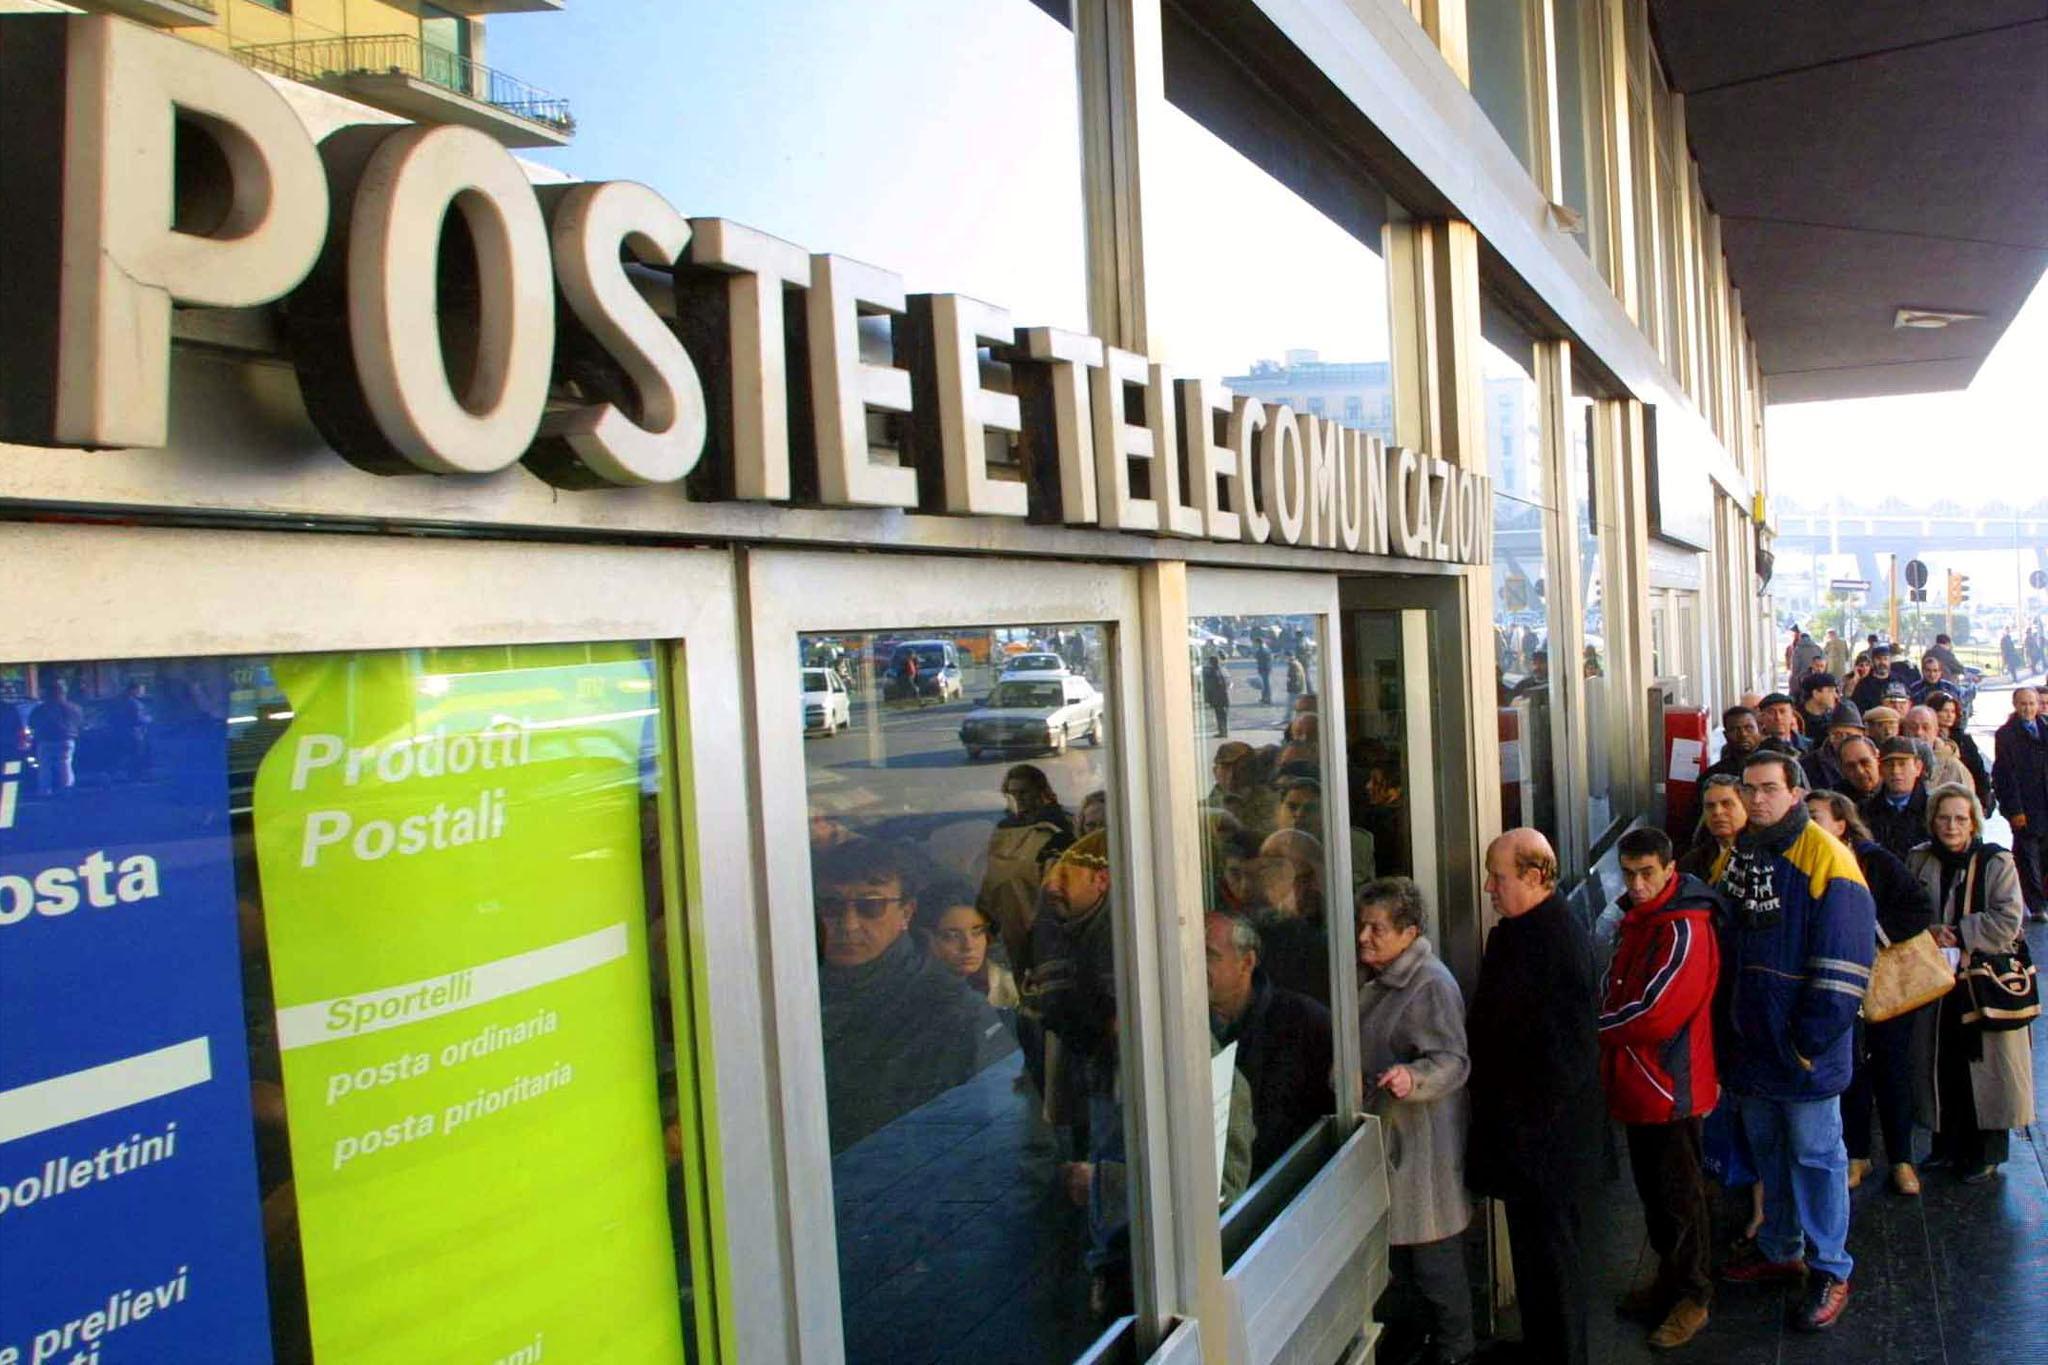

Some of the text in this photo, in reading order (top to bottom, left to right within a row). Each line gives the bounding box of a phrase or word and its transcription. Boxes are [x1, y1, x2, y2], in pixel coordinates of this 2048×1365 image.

[55, 13, 918, 508] POSTE
[932, 293, 1028, 517] E
[291, 716, 532, 791] Prodotti
[301, 788, 508, 868] Postali
[0, 850, 160, 925] osta
[325, 971, 473, 1033] Sportelli
[327, 1009, 558, 1105] posta ordinaria
[333, 1061, 573, 1170] posta prioritaria
[32, 1265, 188, 1365] prelievi
